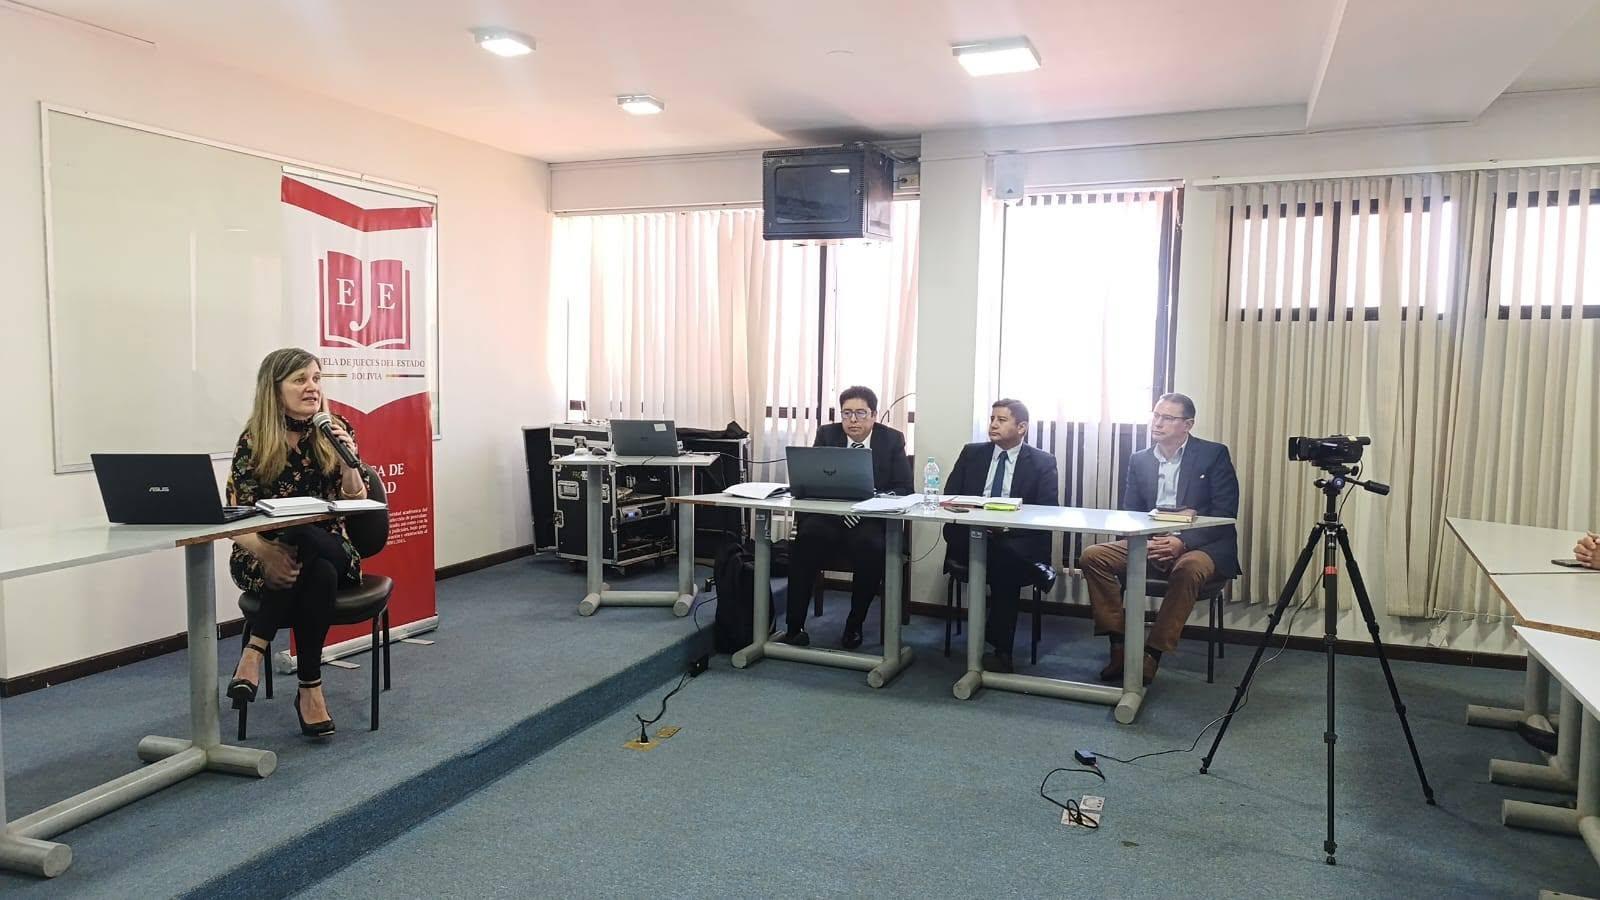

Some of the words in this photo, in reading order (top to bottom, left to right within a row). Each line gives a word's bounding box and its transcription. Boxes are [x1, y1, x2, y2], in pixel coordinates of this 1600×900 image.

[340, 358, 351, 367] DE
[352, 359, 380, 368] JUECES
[397, 360, 425, 368] ESTADO
[351, 372, 383, 380] BOLIVIA
[389, 463, 405, 476] DE
